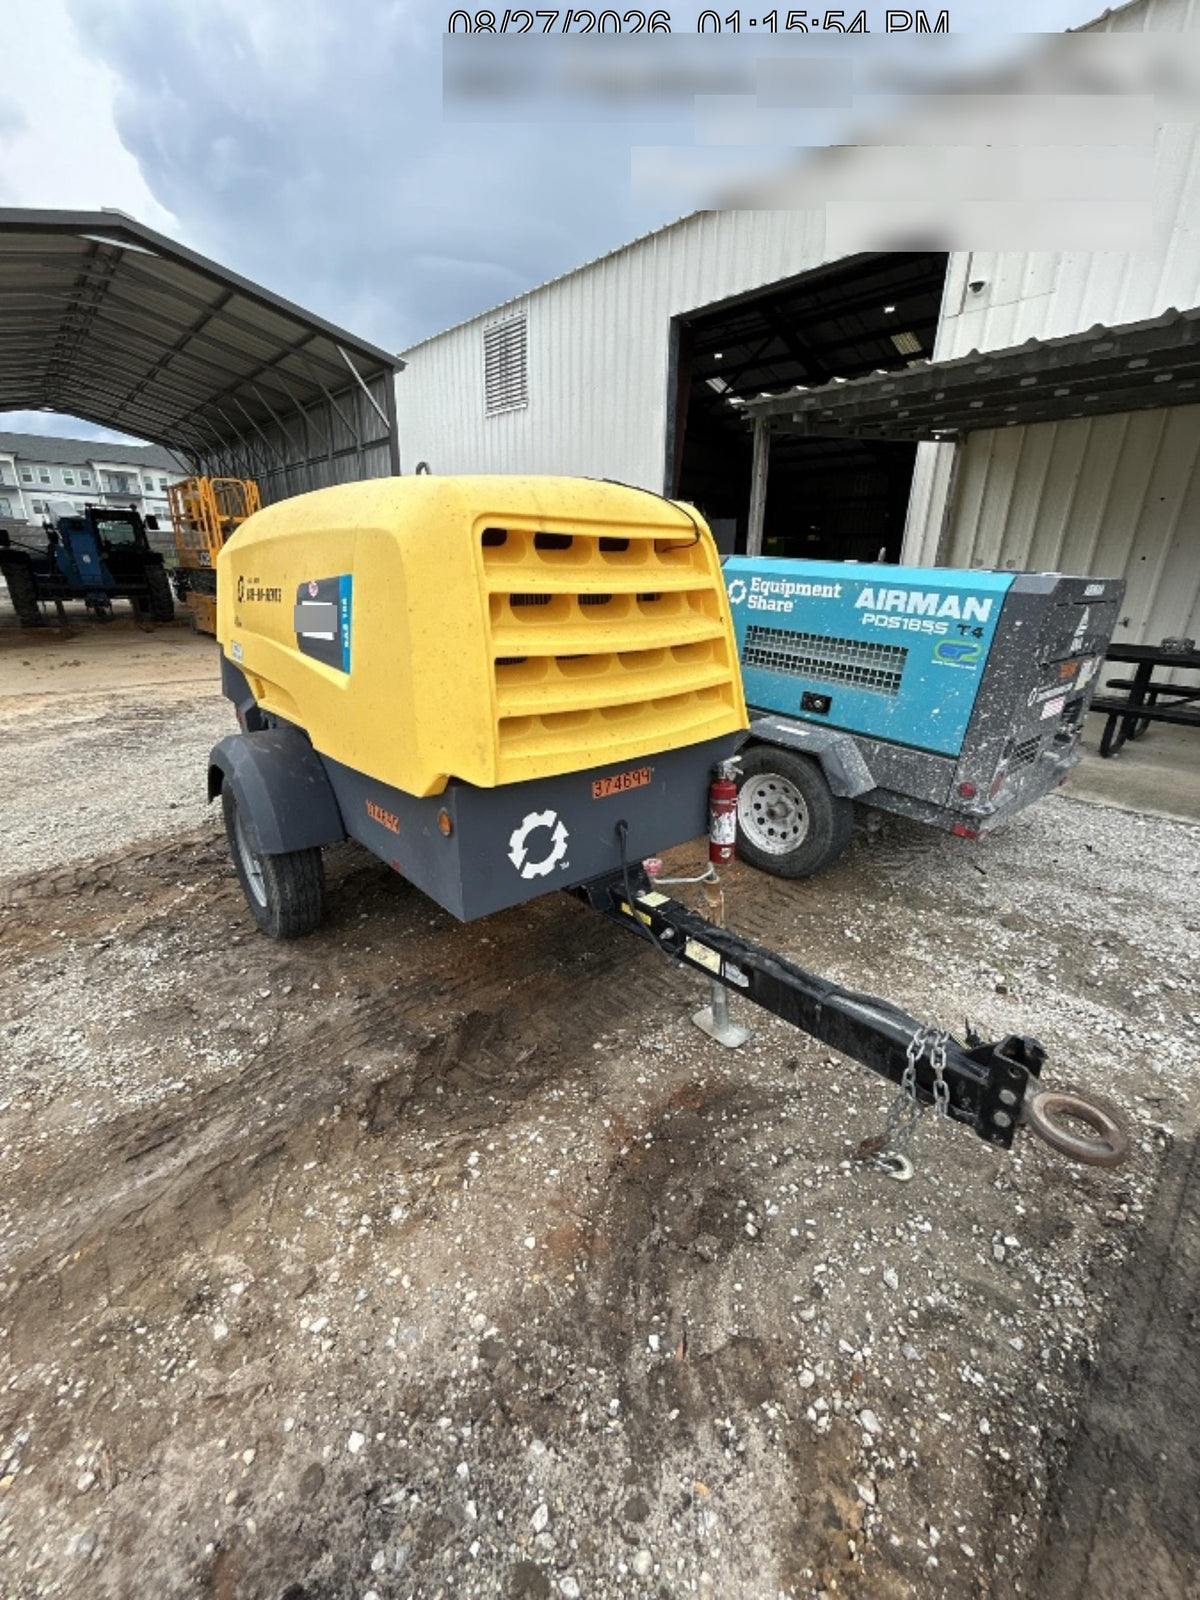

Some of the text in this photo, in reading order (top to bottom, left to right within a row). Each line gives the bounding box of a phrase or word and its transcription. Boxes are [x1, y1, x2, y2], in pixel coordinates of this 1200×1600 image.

[750, 577, 842, 598] Equipment
[747, 595, 794, 612] Share
[853, 587, 993, 622] AIRMAN
[861, 613, 950, 635] PDS185S
